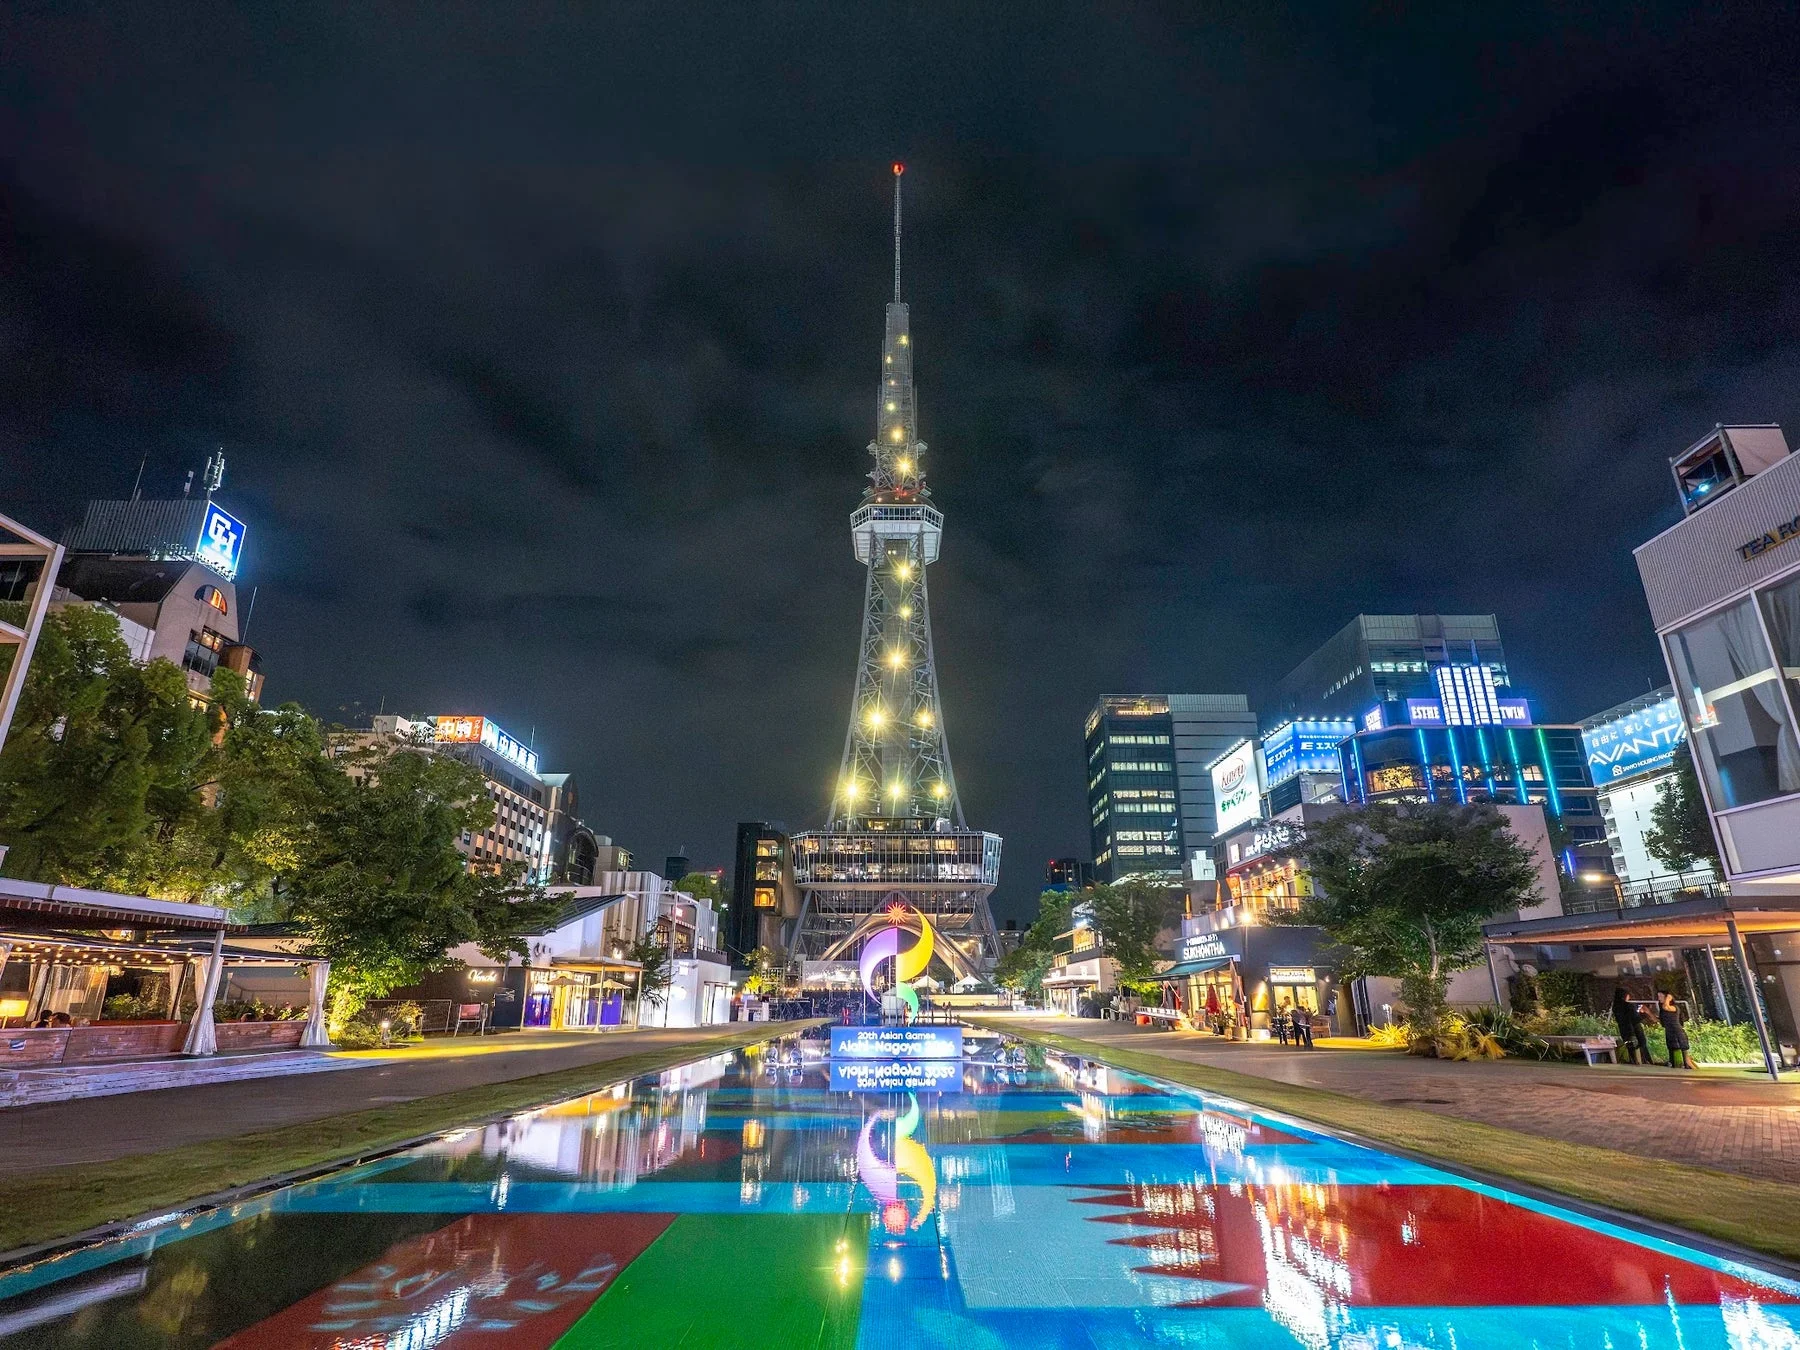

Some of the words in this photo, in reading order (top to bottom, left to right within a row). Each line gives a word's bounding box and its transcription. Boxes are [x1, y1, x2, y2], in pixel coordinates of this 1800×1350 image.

[1735, 534, 1777, 560] TEA
[1411, 705, 1440, 719] ESTHE
[1500, 706, 1526, 719] TWIN
[1183, 941, 1226, 961] SUKHONTHA
[468, 969, 498, 983] Venchi
[857, 1031, 878, 1040] 20th
[880, 1031, 903, 1040] Asian
[905, 1031, 936, 1040] Games
[839, 1040, 922, 1055] Aichi-Nagoya
